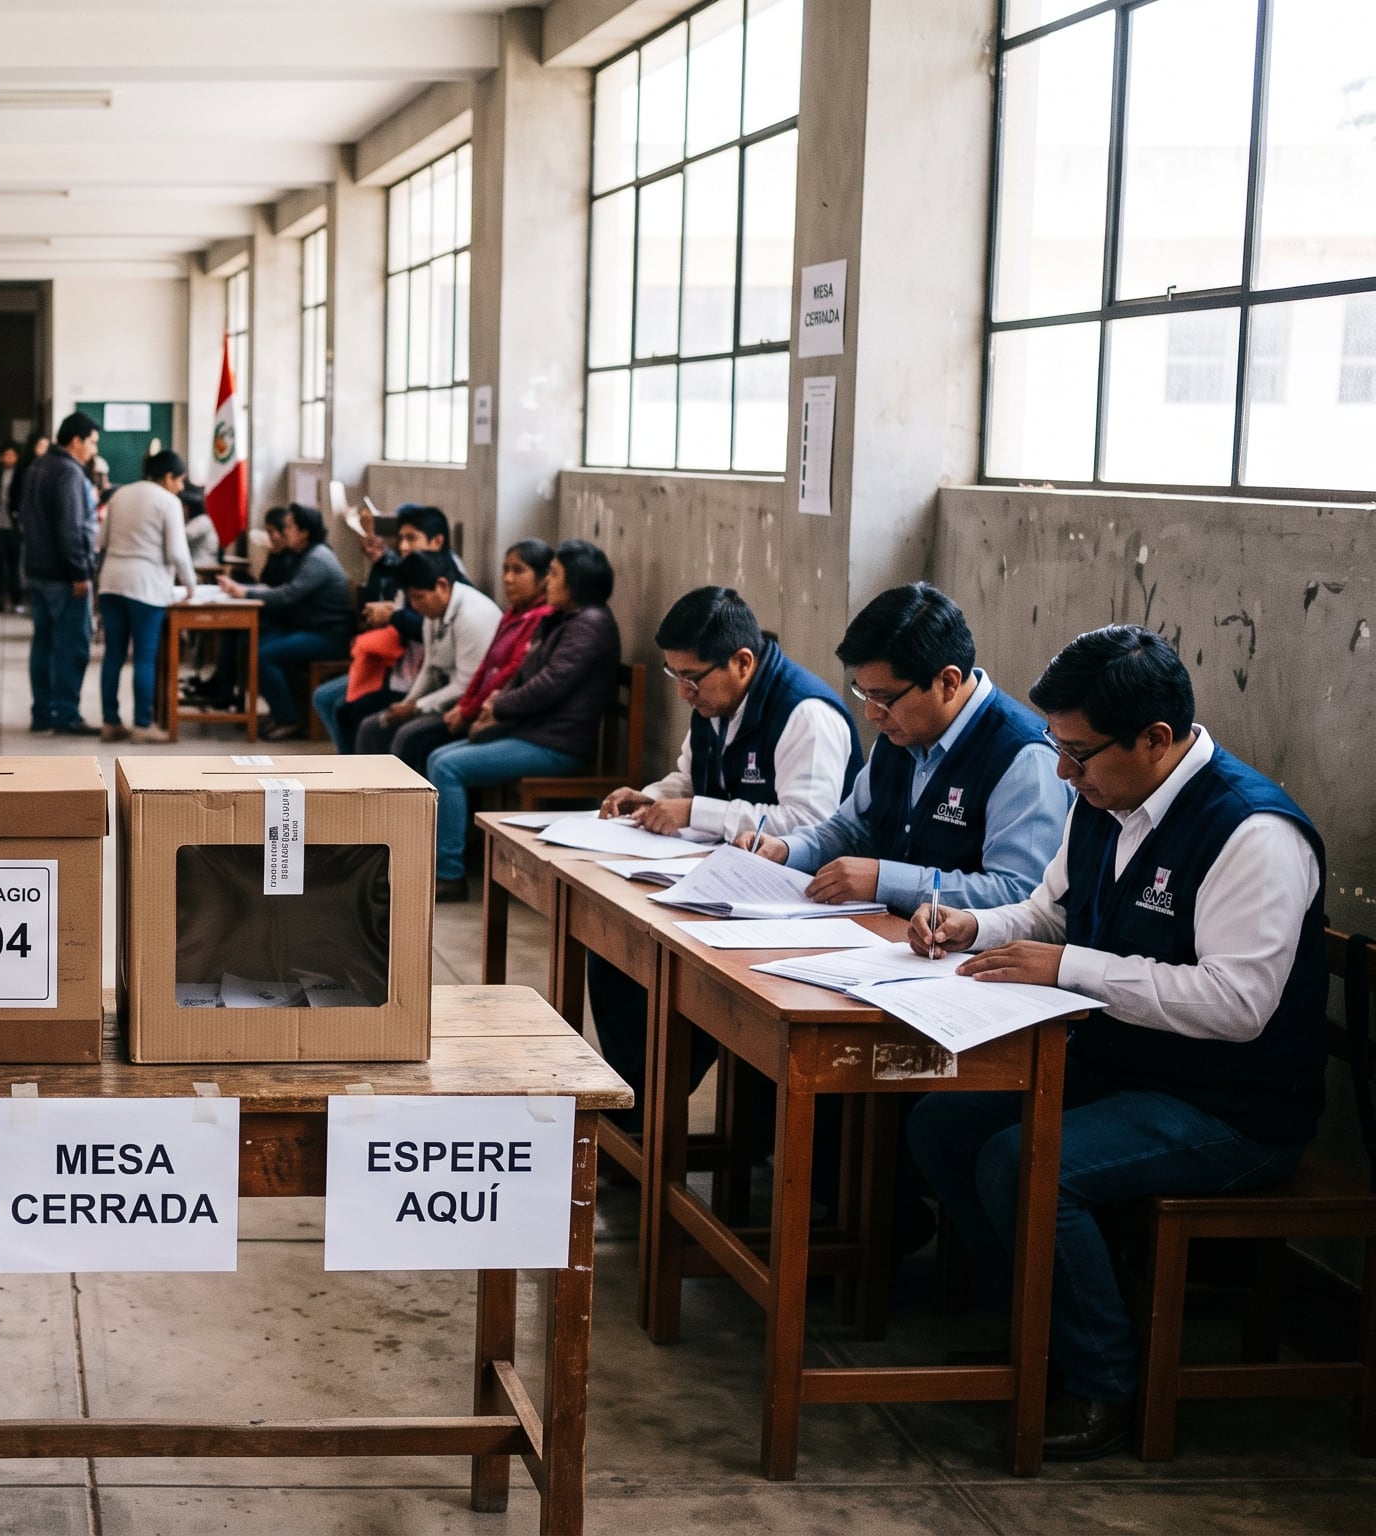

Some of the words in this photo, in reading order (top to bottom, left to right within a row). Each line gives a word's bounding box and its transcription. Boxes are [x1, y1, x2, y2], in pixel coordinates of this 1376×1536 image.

[812, 283, 834, 300] MESA
[56, 1143, 175, 1175] MESA
[367, 1141, 532, 1173] ESPERE
[11, 1193, 219, 1225] CERRADA
[395, 1182, 501, 1225] AQUÍ
